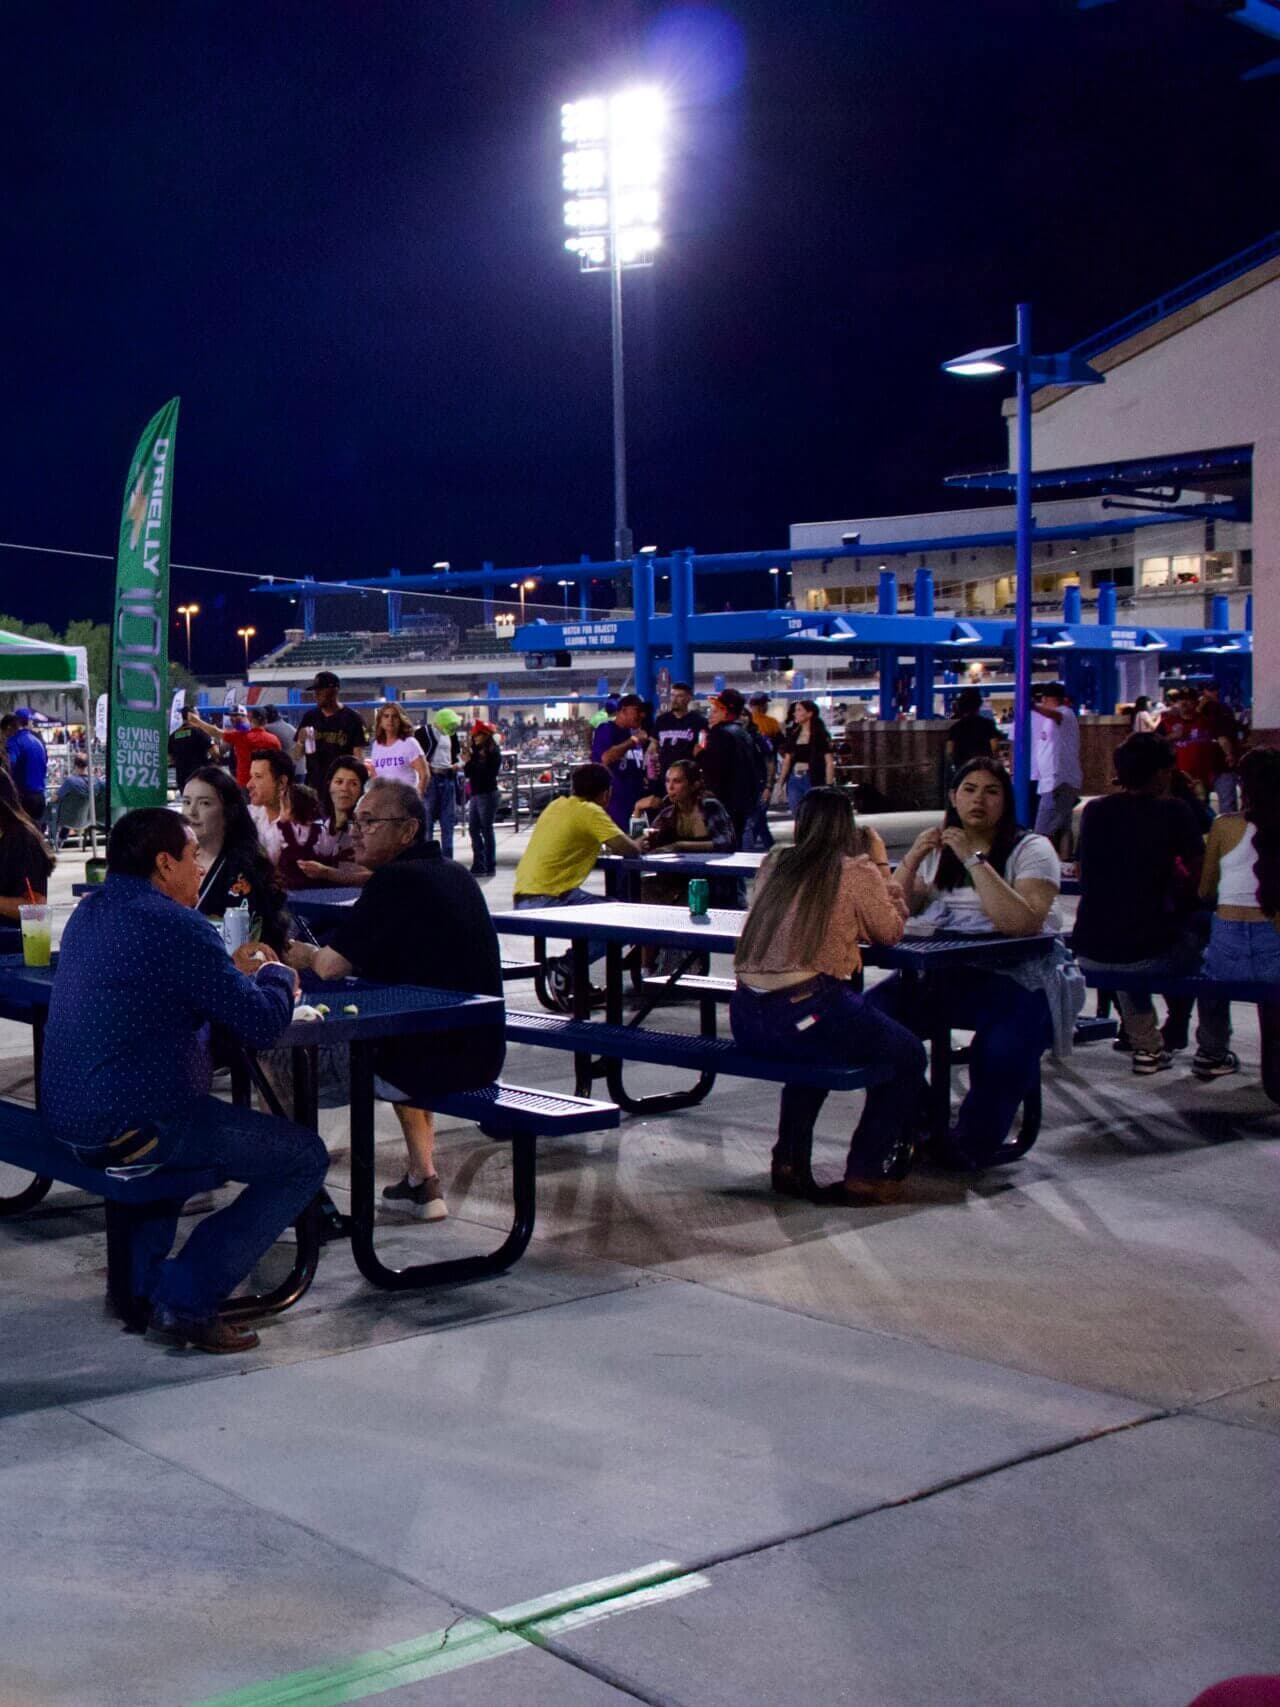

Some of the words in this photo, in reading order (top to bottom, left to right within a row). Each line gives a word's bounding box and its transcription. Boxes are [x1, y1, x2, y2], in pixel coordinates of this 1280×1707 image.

[117, 725, 160, 743] GIVING
[118, 739, 136, 750] YOU
[138, 740, 160, 753] MORE
[116, 749, 160, 767] SINCE
[117, 764, 161, 790] 1924
